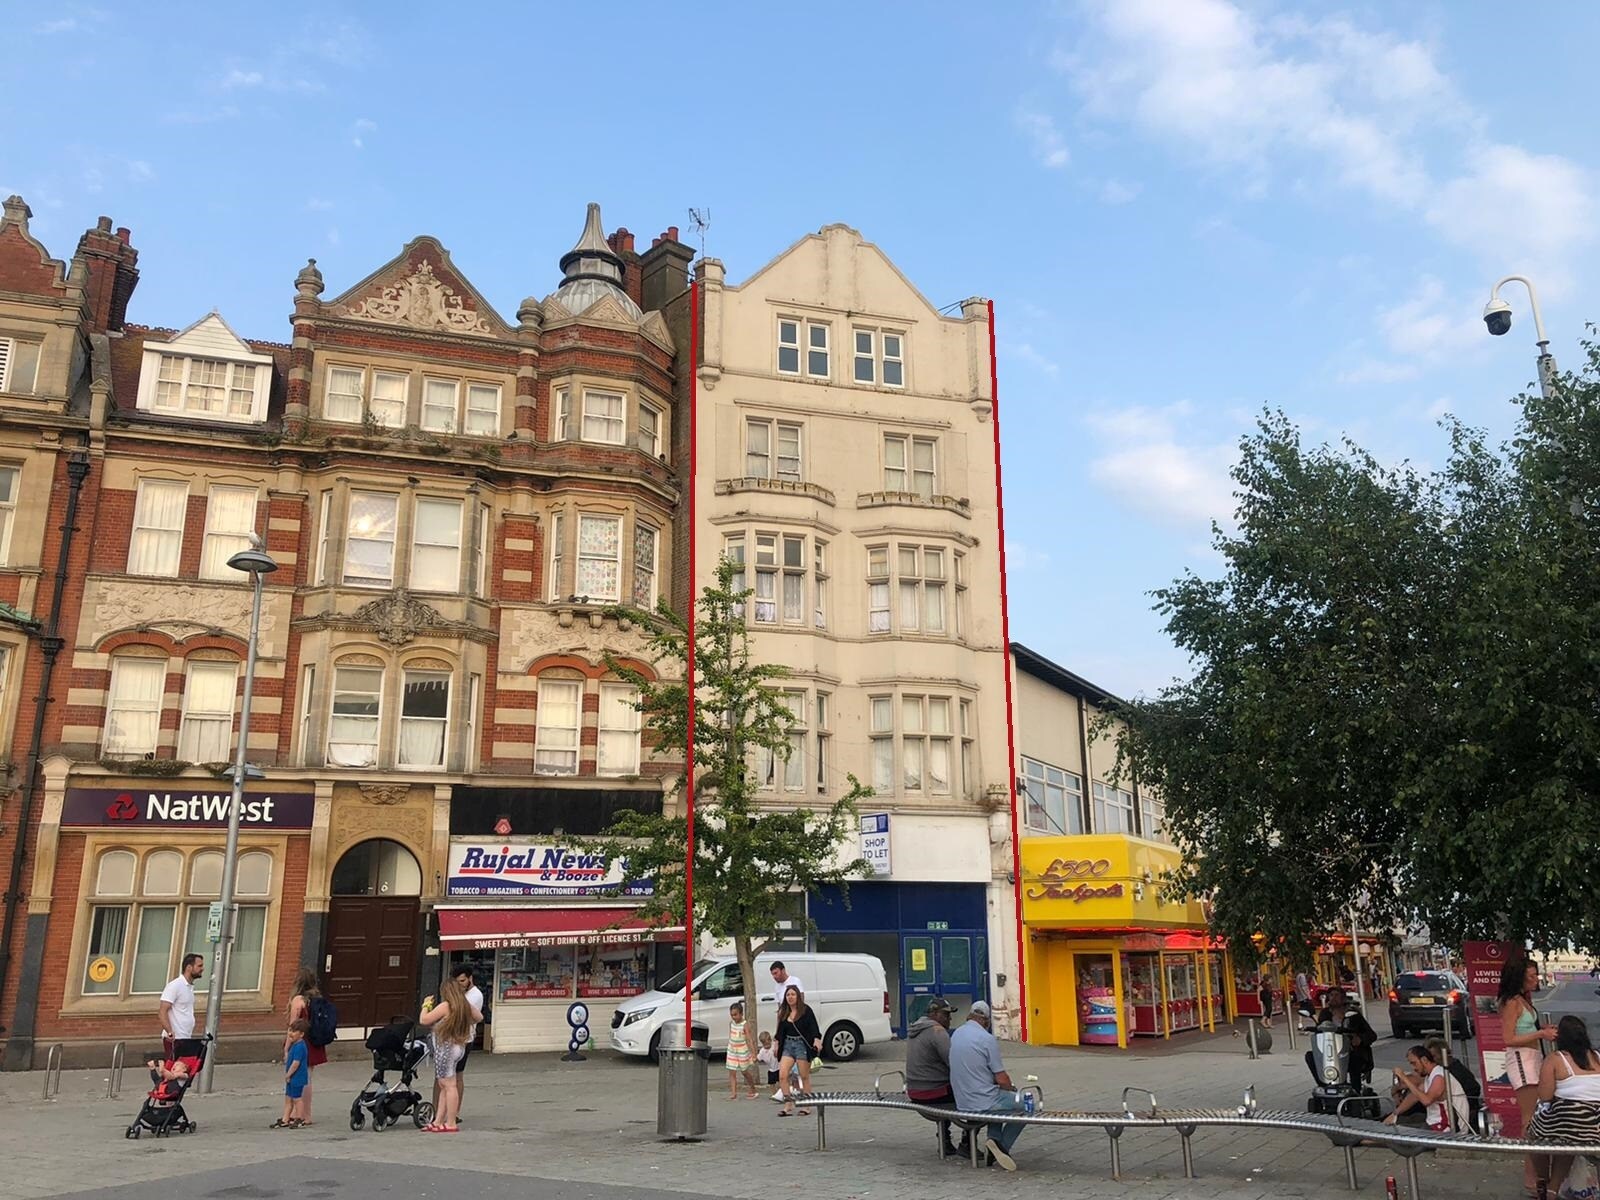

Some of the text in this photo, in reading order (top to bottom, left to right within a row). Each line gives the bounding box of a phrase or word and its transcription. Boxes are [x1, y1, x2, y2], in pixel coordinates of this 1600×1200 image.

[146, 793, 275, 822] NatWest
[865, 838, 885, 847] SHOP
[460, 846, 536, 874] Rujal
[863, 849, 888, 859] TO LET
[540, 869, 598, 881] & Booze
[1038, 858, 1112, 881] £500
[451, 887, 480, 895] TOBACCO
[486, 887, 524, 895] MAGAZINES
[530, 887, 579, 895] CONFECTIONERY
[631, 887, 654, 895] TOP-UP
[474, 940, 500, 949] SWEET
[502, 939, 509, 947] &
[510, 938, 530, 947] ROCK
[537, 937, 556, 946] SOFT
[557, 936, 578, 945] DRINK
[580, 936, 586, 944] &
[587, 935, 601, 944] OFF
[602, 934, 632, 943] LICENCE
[633, 933, 655, 942] STE
